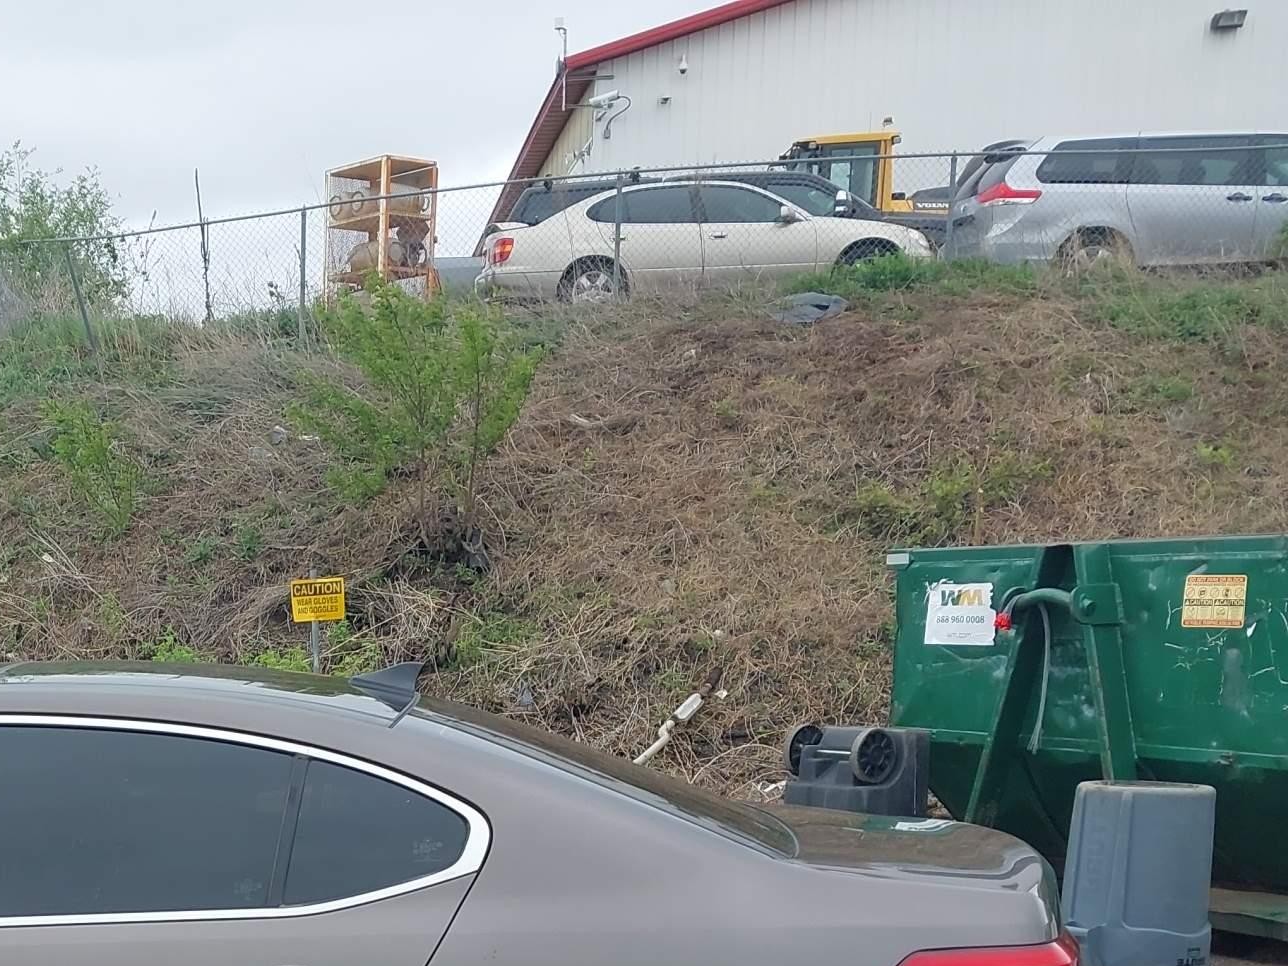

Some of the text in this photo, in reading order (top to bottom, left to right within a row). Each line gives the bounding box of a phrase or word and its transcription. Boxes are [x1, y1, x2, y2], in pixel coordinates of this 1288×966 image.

[294, 582, 340, 595] CAUTION
[296, 596, 338, 606] WEAR GLOVES
[941, 589, 983, 606] WM
[309, 605, 338, 614] GOGGLES
